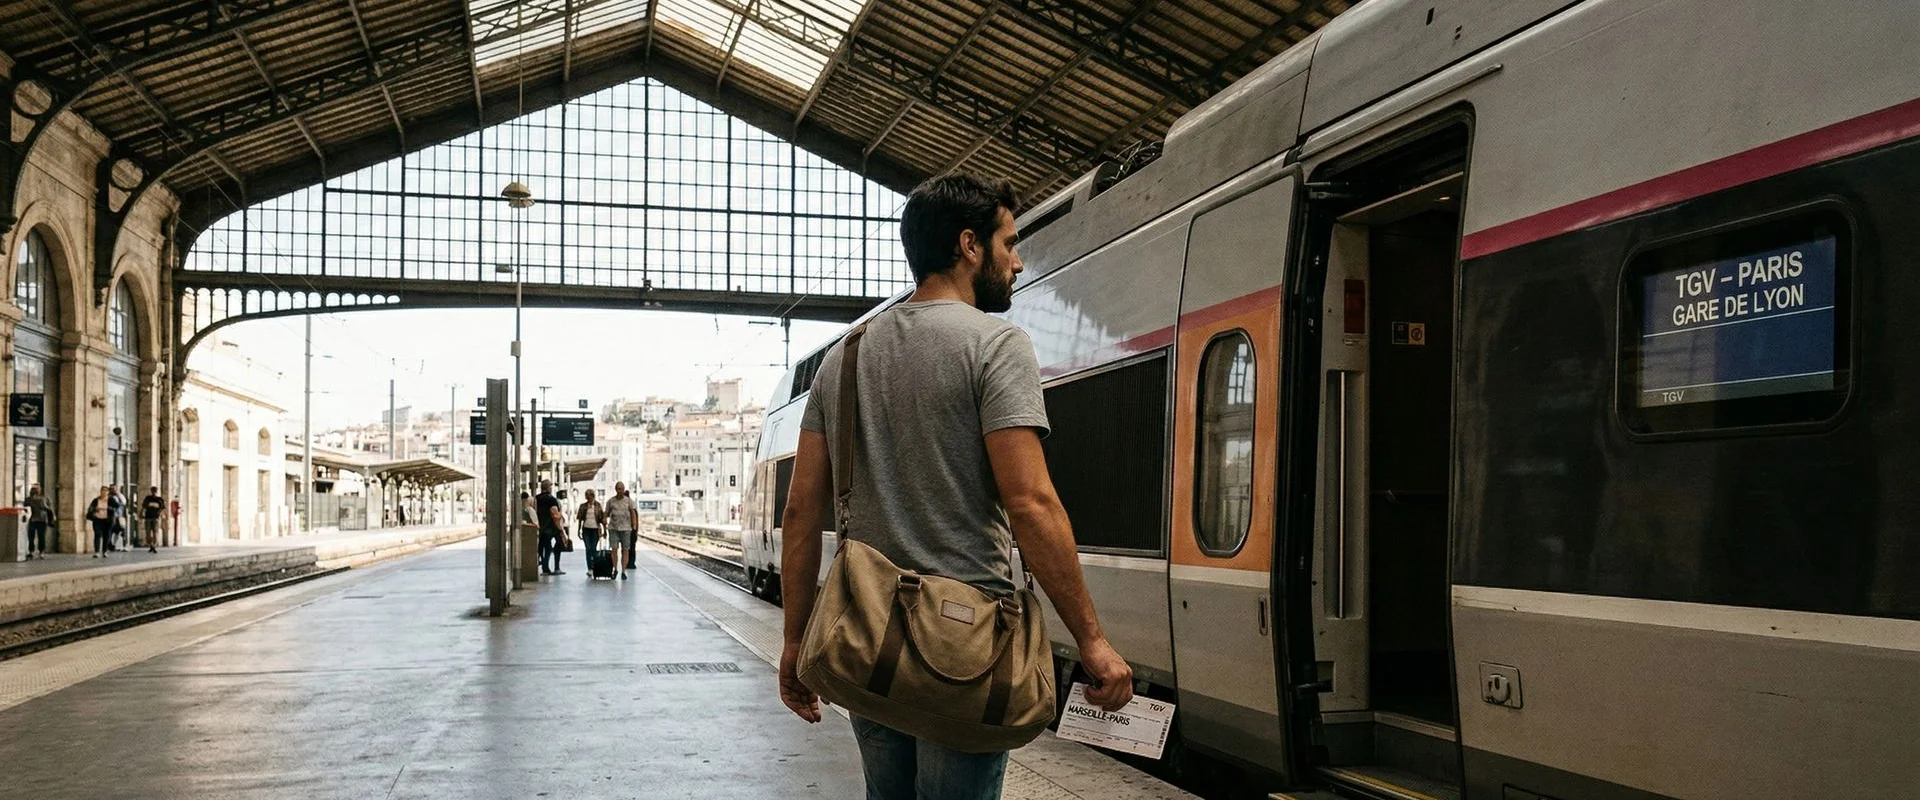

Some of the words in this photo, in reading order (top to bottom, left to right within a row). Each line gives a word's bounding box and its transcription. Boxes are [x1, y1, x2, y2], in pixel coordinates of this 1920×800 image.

[1675, 268, 1716, 298] TGV
[1738, 251, 1803, 287] PARIS
[1672, 298, 1720, 326] GARE
[1724, 293, 1748, 318] DE
[1753, 283, 1804, 313] LYON
[1662, 390, 1685, 403] TGV
[1149, 703, 1166, 712] TGV
